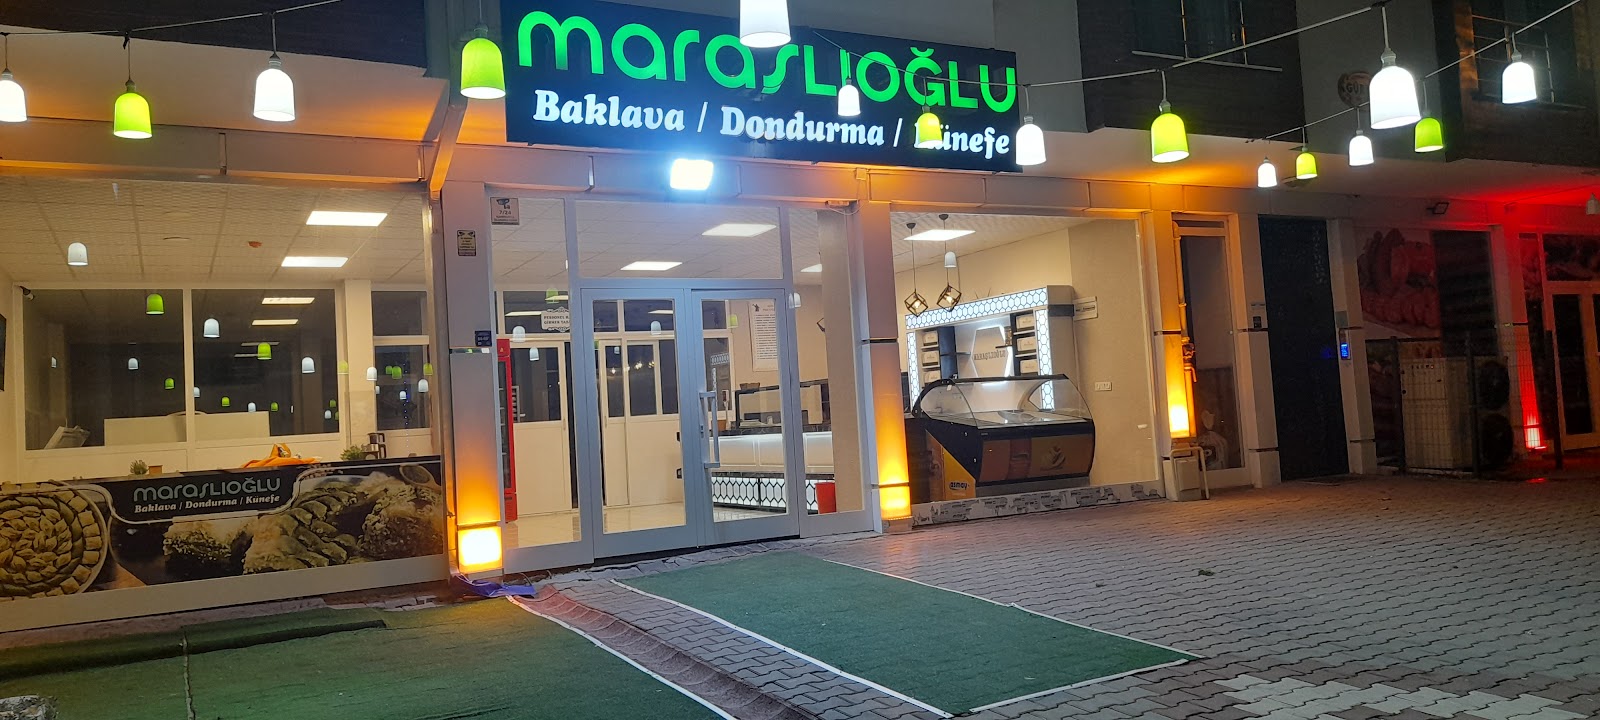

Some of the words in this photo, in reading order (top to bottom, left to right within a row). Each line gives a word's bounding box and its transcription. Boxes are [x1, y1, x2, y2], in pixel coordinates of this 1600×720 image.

[533, 89, 685, 131] Baklava
[720, 106, 884, 147] Dondurma
[914, 121, 1010, 160] ünefe
[134, 503, 177, 514] Baklava
[185, 497, 237, 509] Dondurma
[245, 494, 280, 504] Künefe
